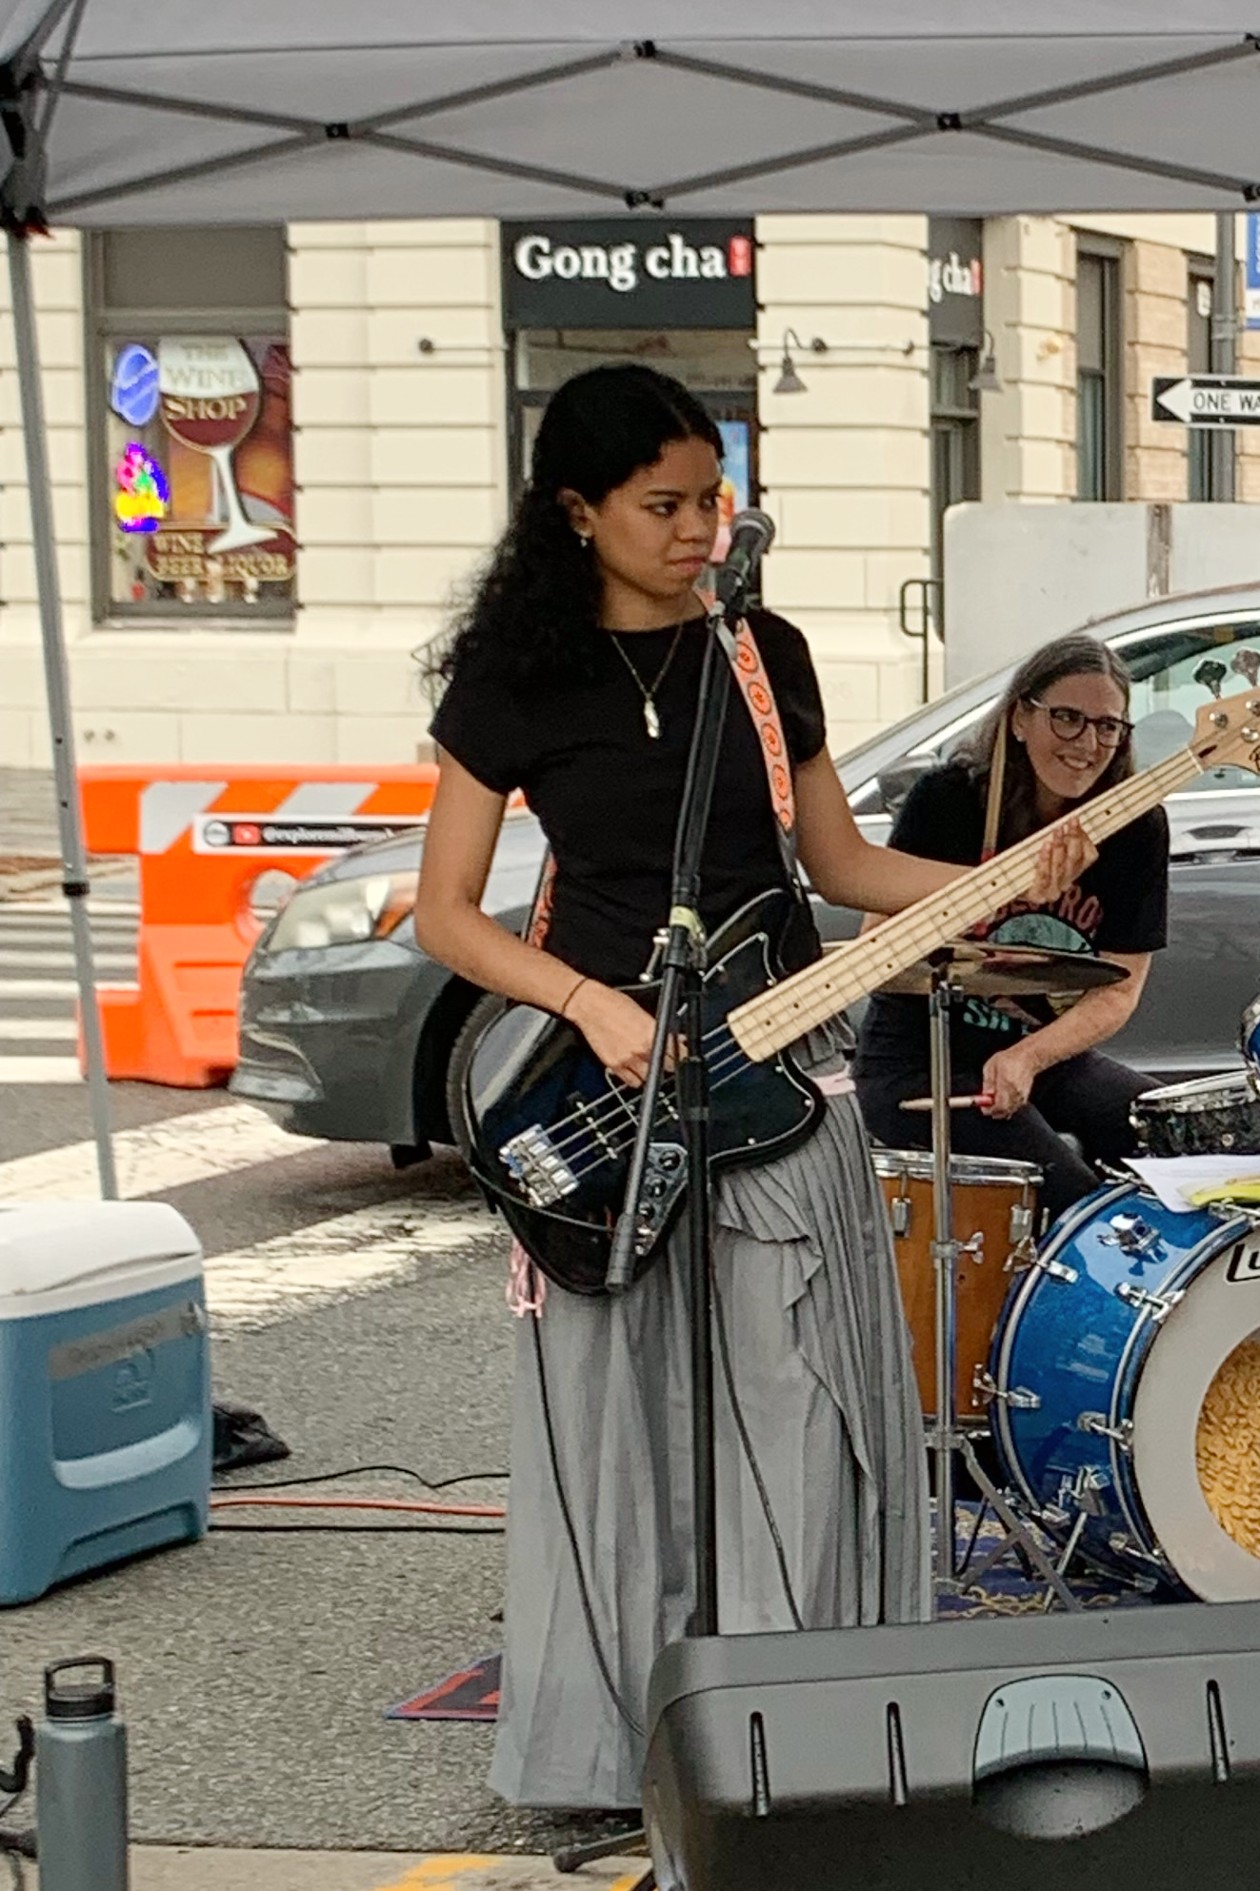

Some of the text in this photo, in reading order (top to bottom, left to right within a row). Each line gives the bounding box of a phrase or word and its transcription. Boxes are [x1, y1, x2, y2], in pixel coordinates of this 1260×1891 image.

[514, 235, 637, 292] Gong
[645, 232, 728, 279] cha
[942, 251, 972, 296] cha
[165, 366, 241, 389] WINE
[164, 396, 248, 421] SHOP
[1193, 391, 1232, 412] ONE
[153, 532, 203, 554] WINE
